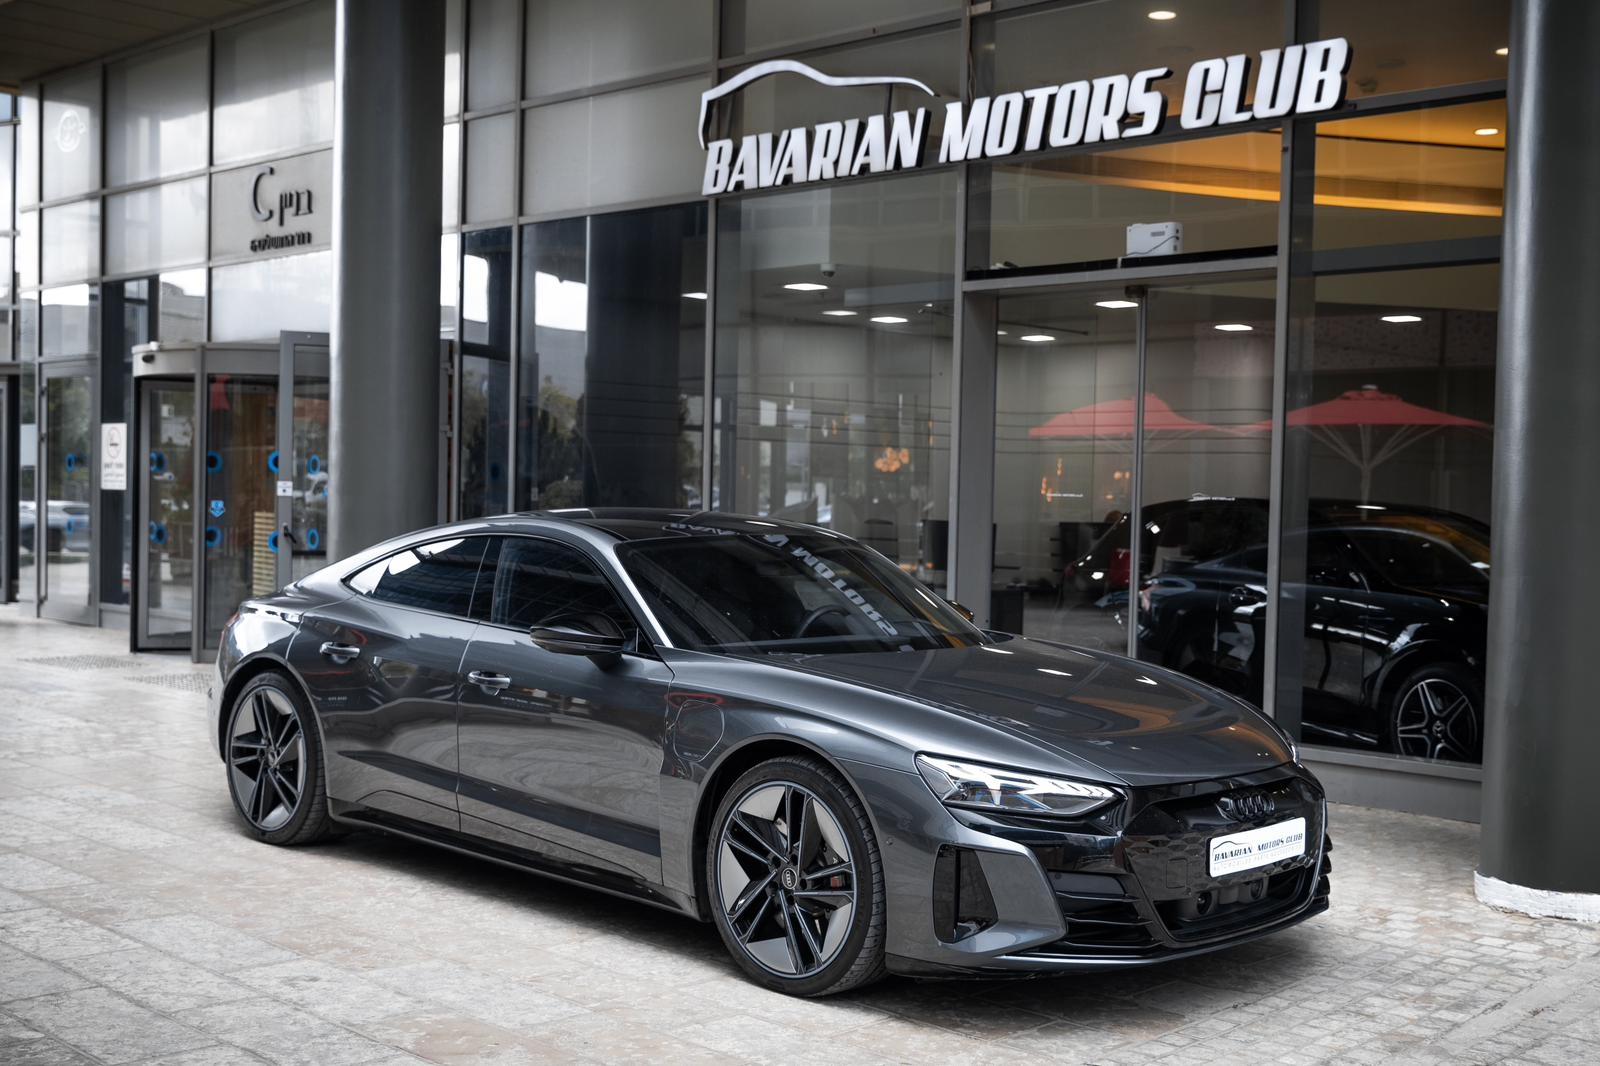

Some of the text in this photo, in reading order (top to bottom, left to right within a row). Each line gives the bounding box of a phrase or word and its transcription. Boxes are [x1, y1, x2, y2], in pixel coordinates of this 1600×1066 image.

[702, 37, 1349, 195] BAVARIAN MOTORS CLUB
[1214, 847, 1252, 861] BAVARIAN
[1257, 838, 1284, 851] MOTORS
[1285, 833, 1303, 844] CLUB
